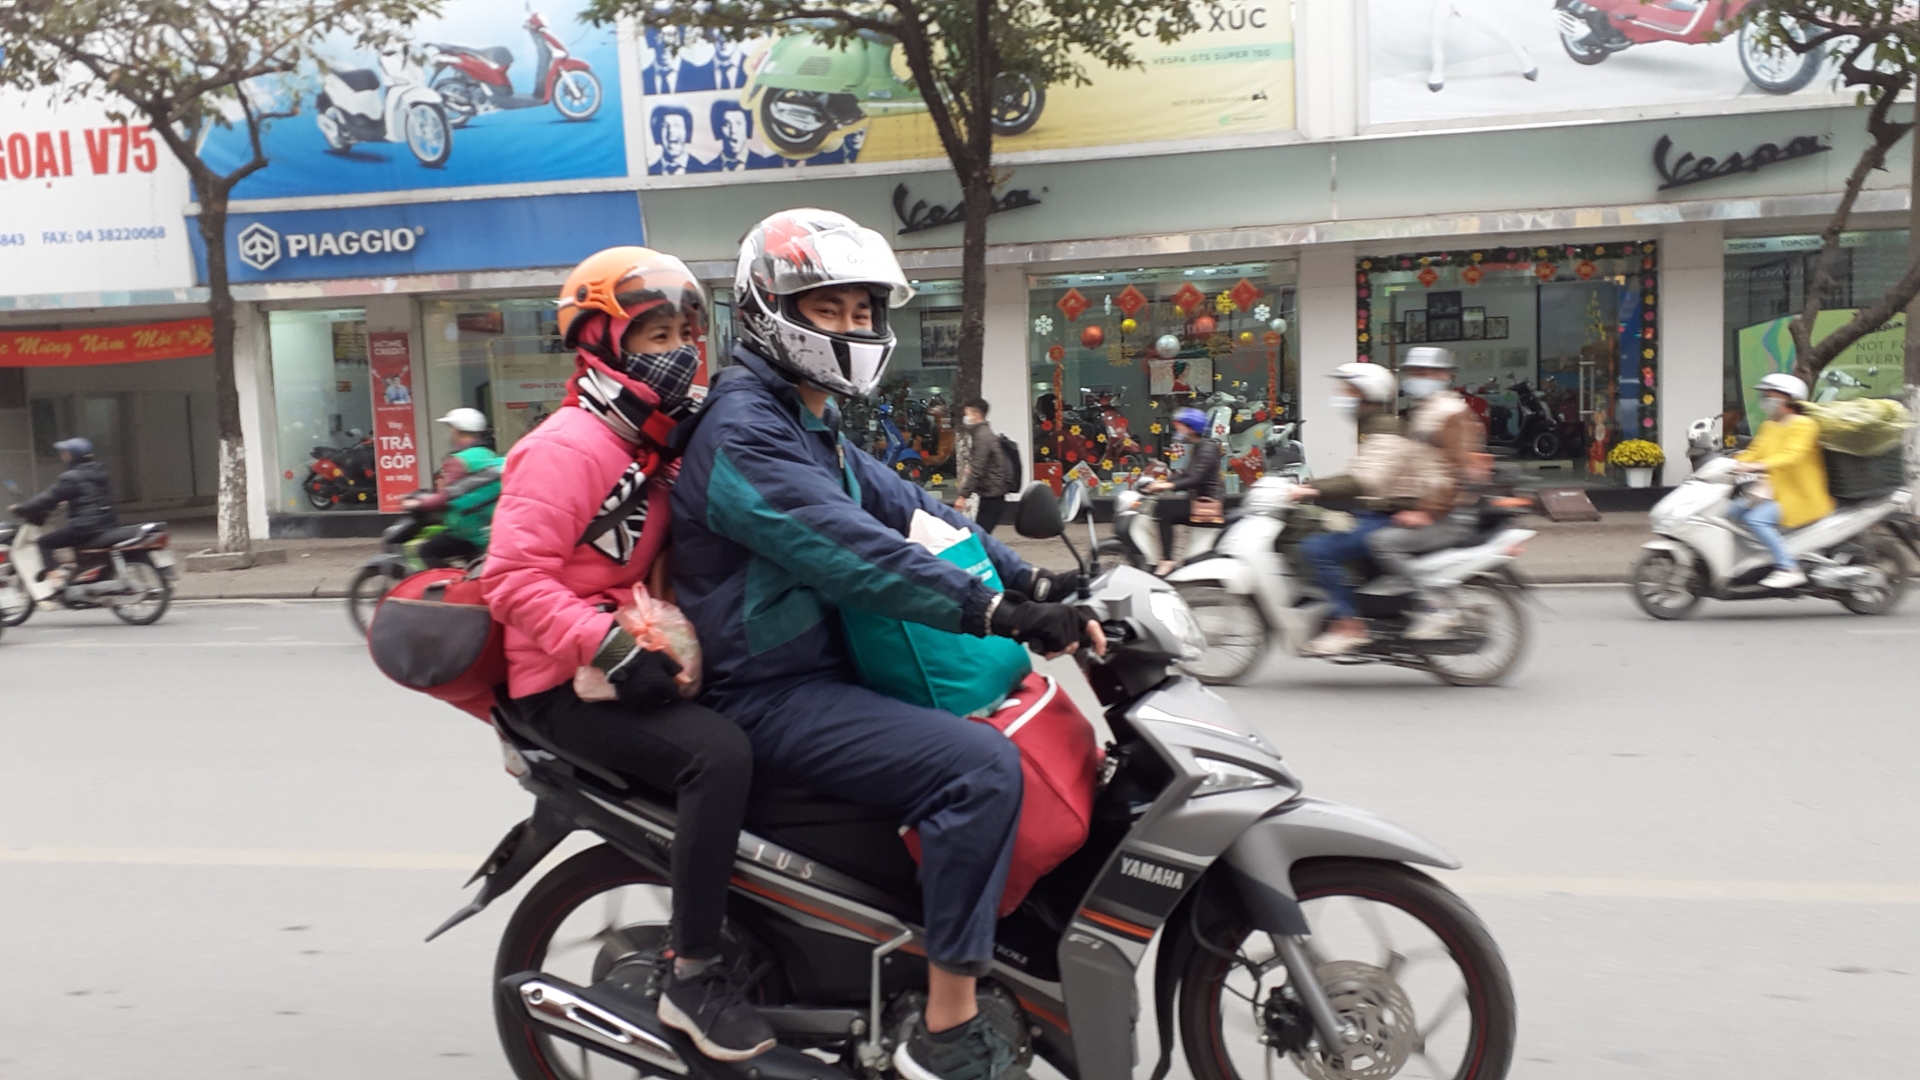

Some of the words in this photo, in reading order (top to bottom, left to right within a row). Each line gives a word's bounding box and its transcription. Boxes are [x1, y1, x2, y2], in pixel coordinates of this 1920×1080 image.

[1208, 4, 1267, 32] XÚC
[83, 126, 157, 175] V75
[1653, 134, 1834, 191] Vespa
[893, 182, 1042, 236] Vesa
[42, 231, 73, 245] FAX:
[76, 230, 93, 242] 04
[98, 226, 166, 241] 38220068
[286, 228, 416, 258] PIAGGIO
[1856, 340, 1883, 350] NOT
[1120, 857, 1185, 890] YAMAHA
